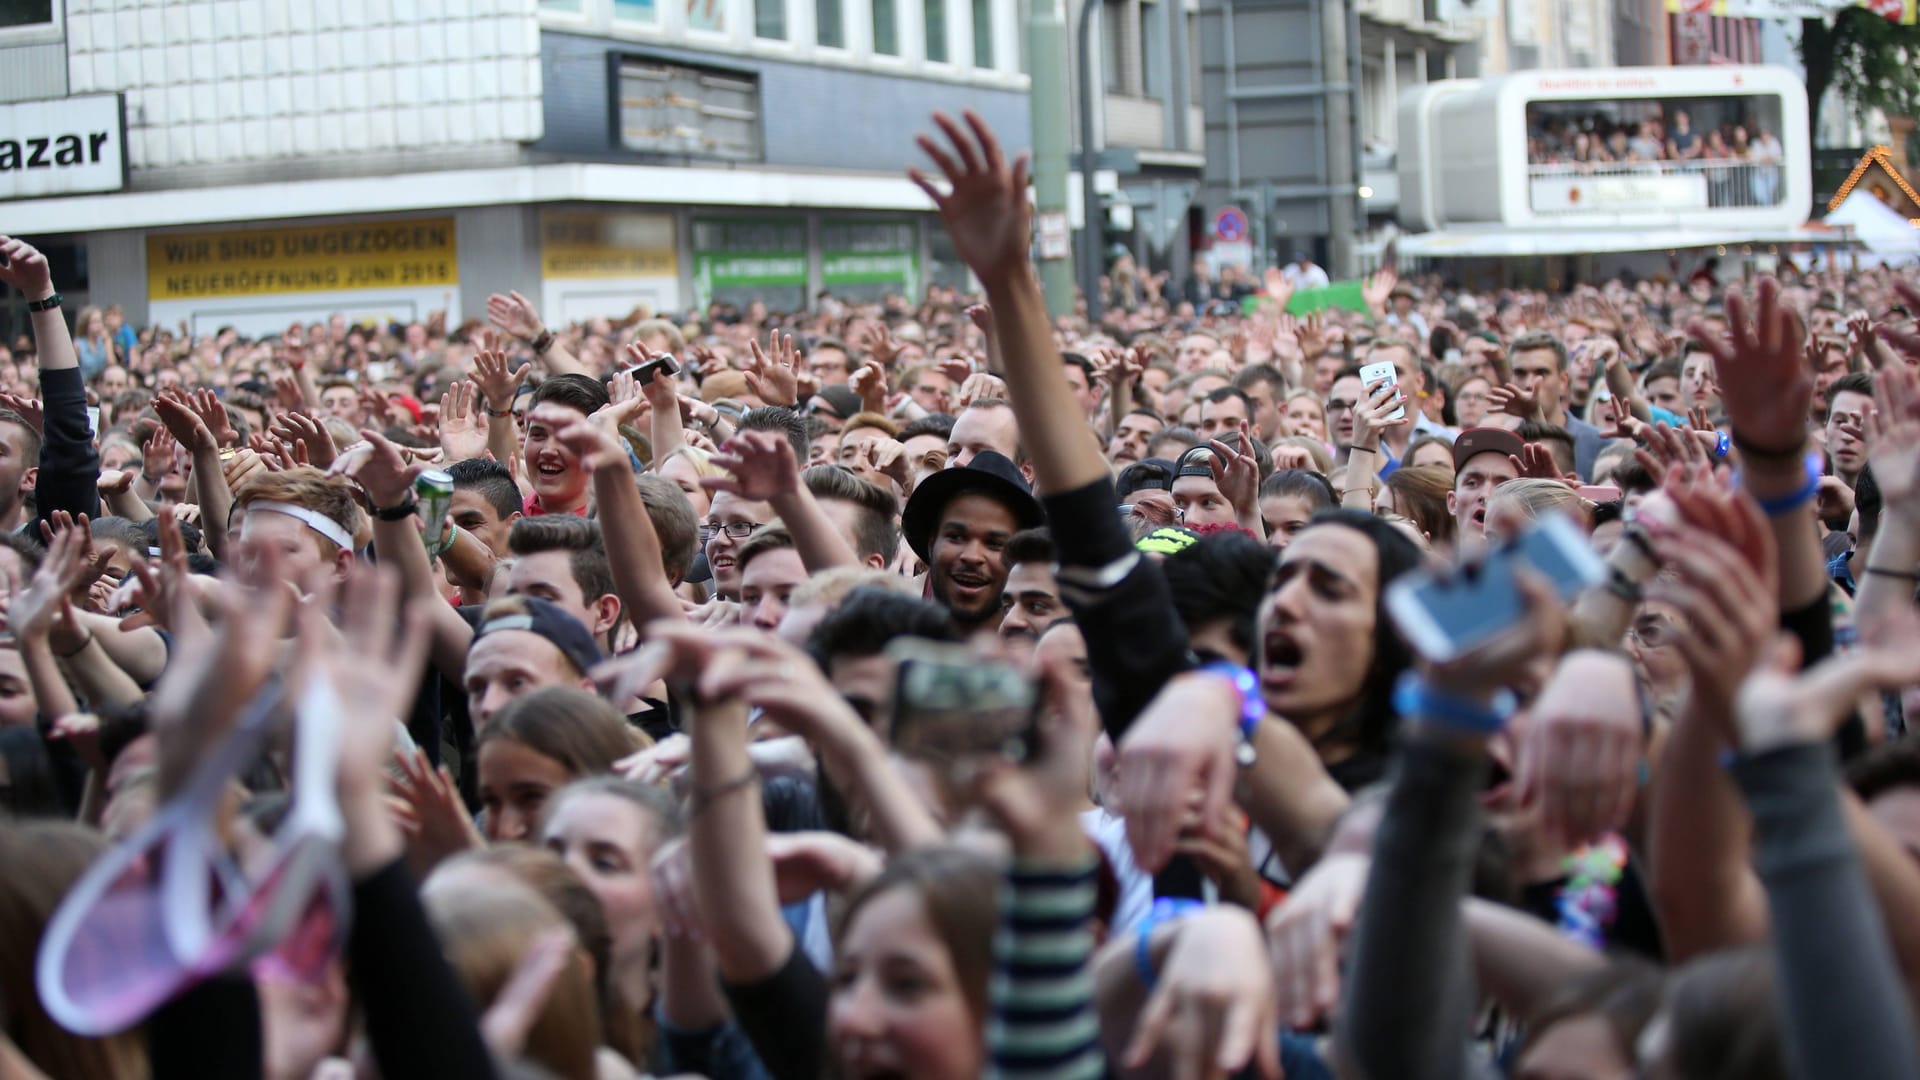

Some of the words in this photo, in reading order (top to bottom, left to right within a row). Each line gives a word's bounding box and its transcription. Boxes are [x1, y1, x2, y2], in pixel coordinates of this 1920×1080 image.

[165, 239, 209, 264] WIR
[218, 236, 275, 261] SIND
[283, 227, 447, 258] UMGEZOGEN
[166, 267, 338, 294] NEUERÖFFNUNG
[347, 264, 393, 284] JUNI
